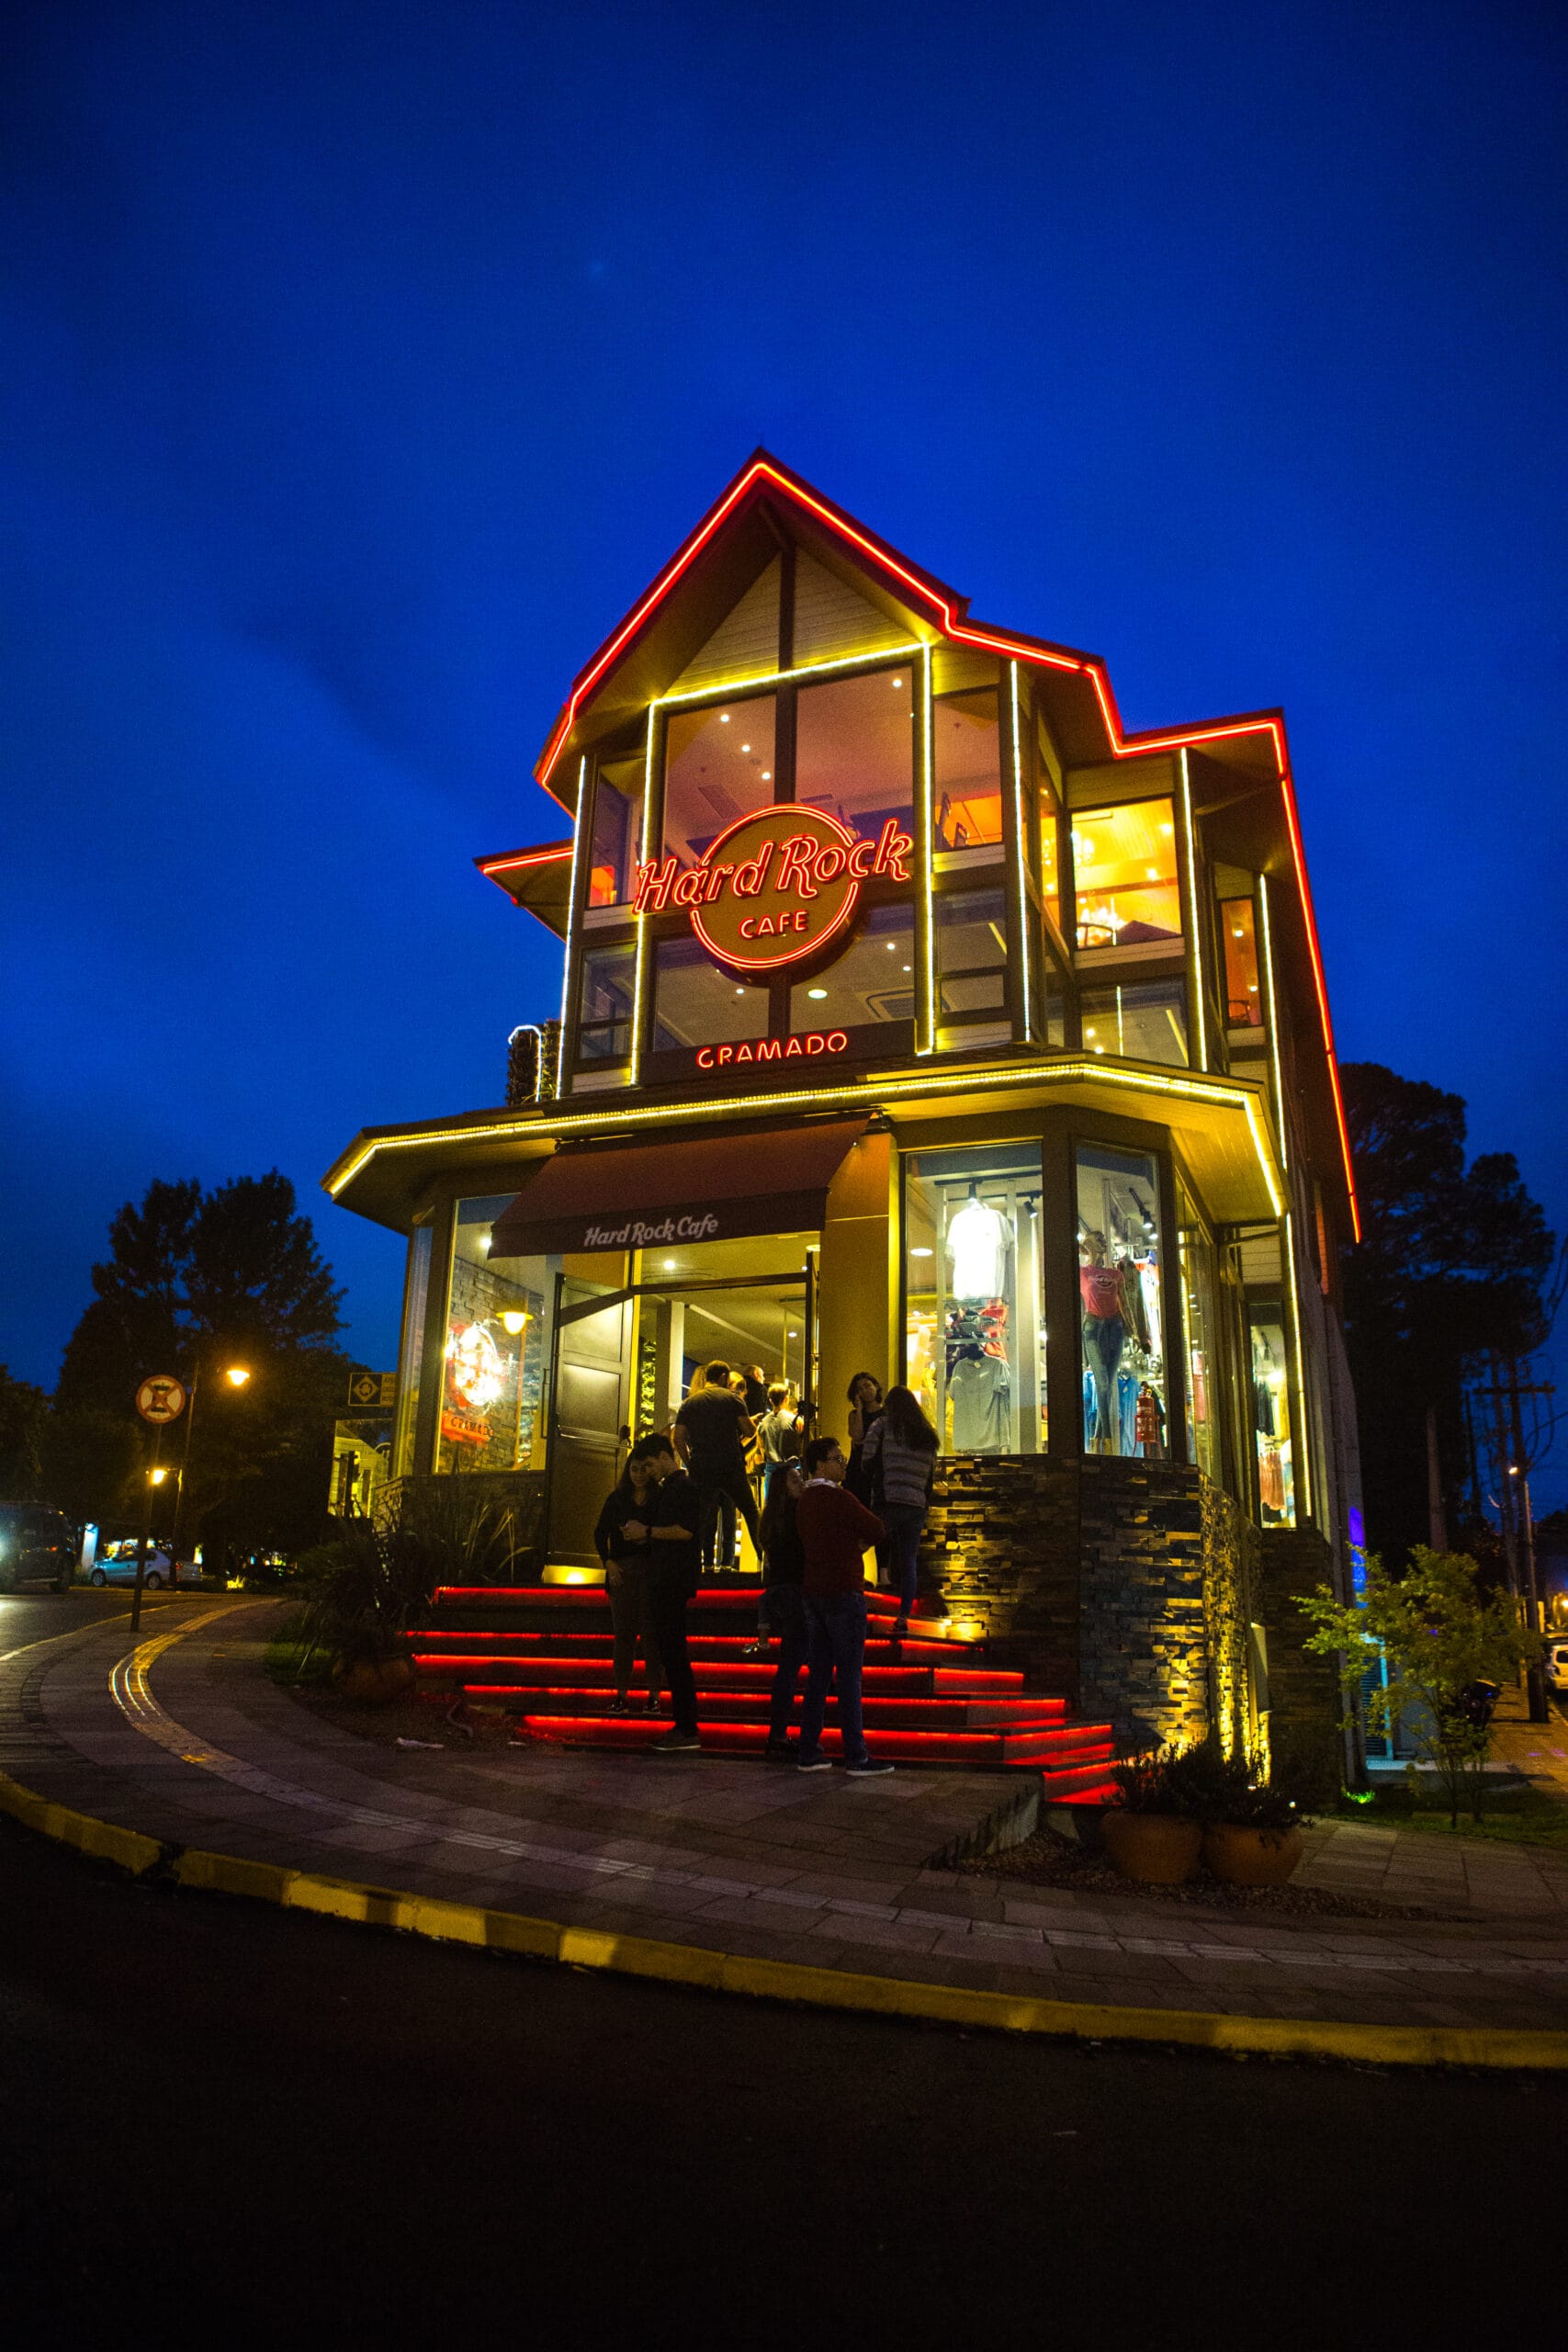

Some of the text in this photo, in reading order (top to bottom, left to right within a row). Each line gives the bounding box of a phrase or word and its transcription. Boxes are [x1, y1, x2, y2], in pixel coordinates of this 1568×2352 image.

[633, 818, 914, 913] Hard Rock
[739, 910, 808, 940] CAFE
[696, 1031, 848, 1070] GRAMADO
[583, 1214, 718, 1247] Hard Rock Cafe
